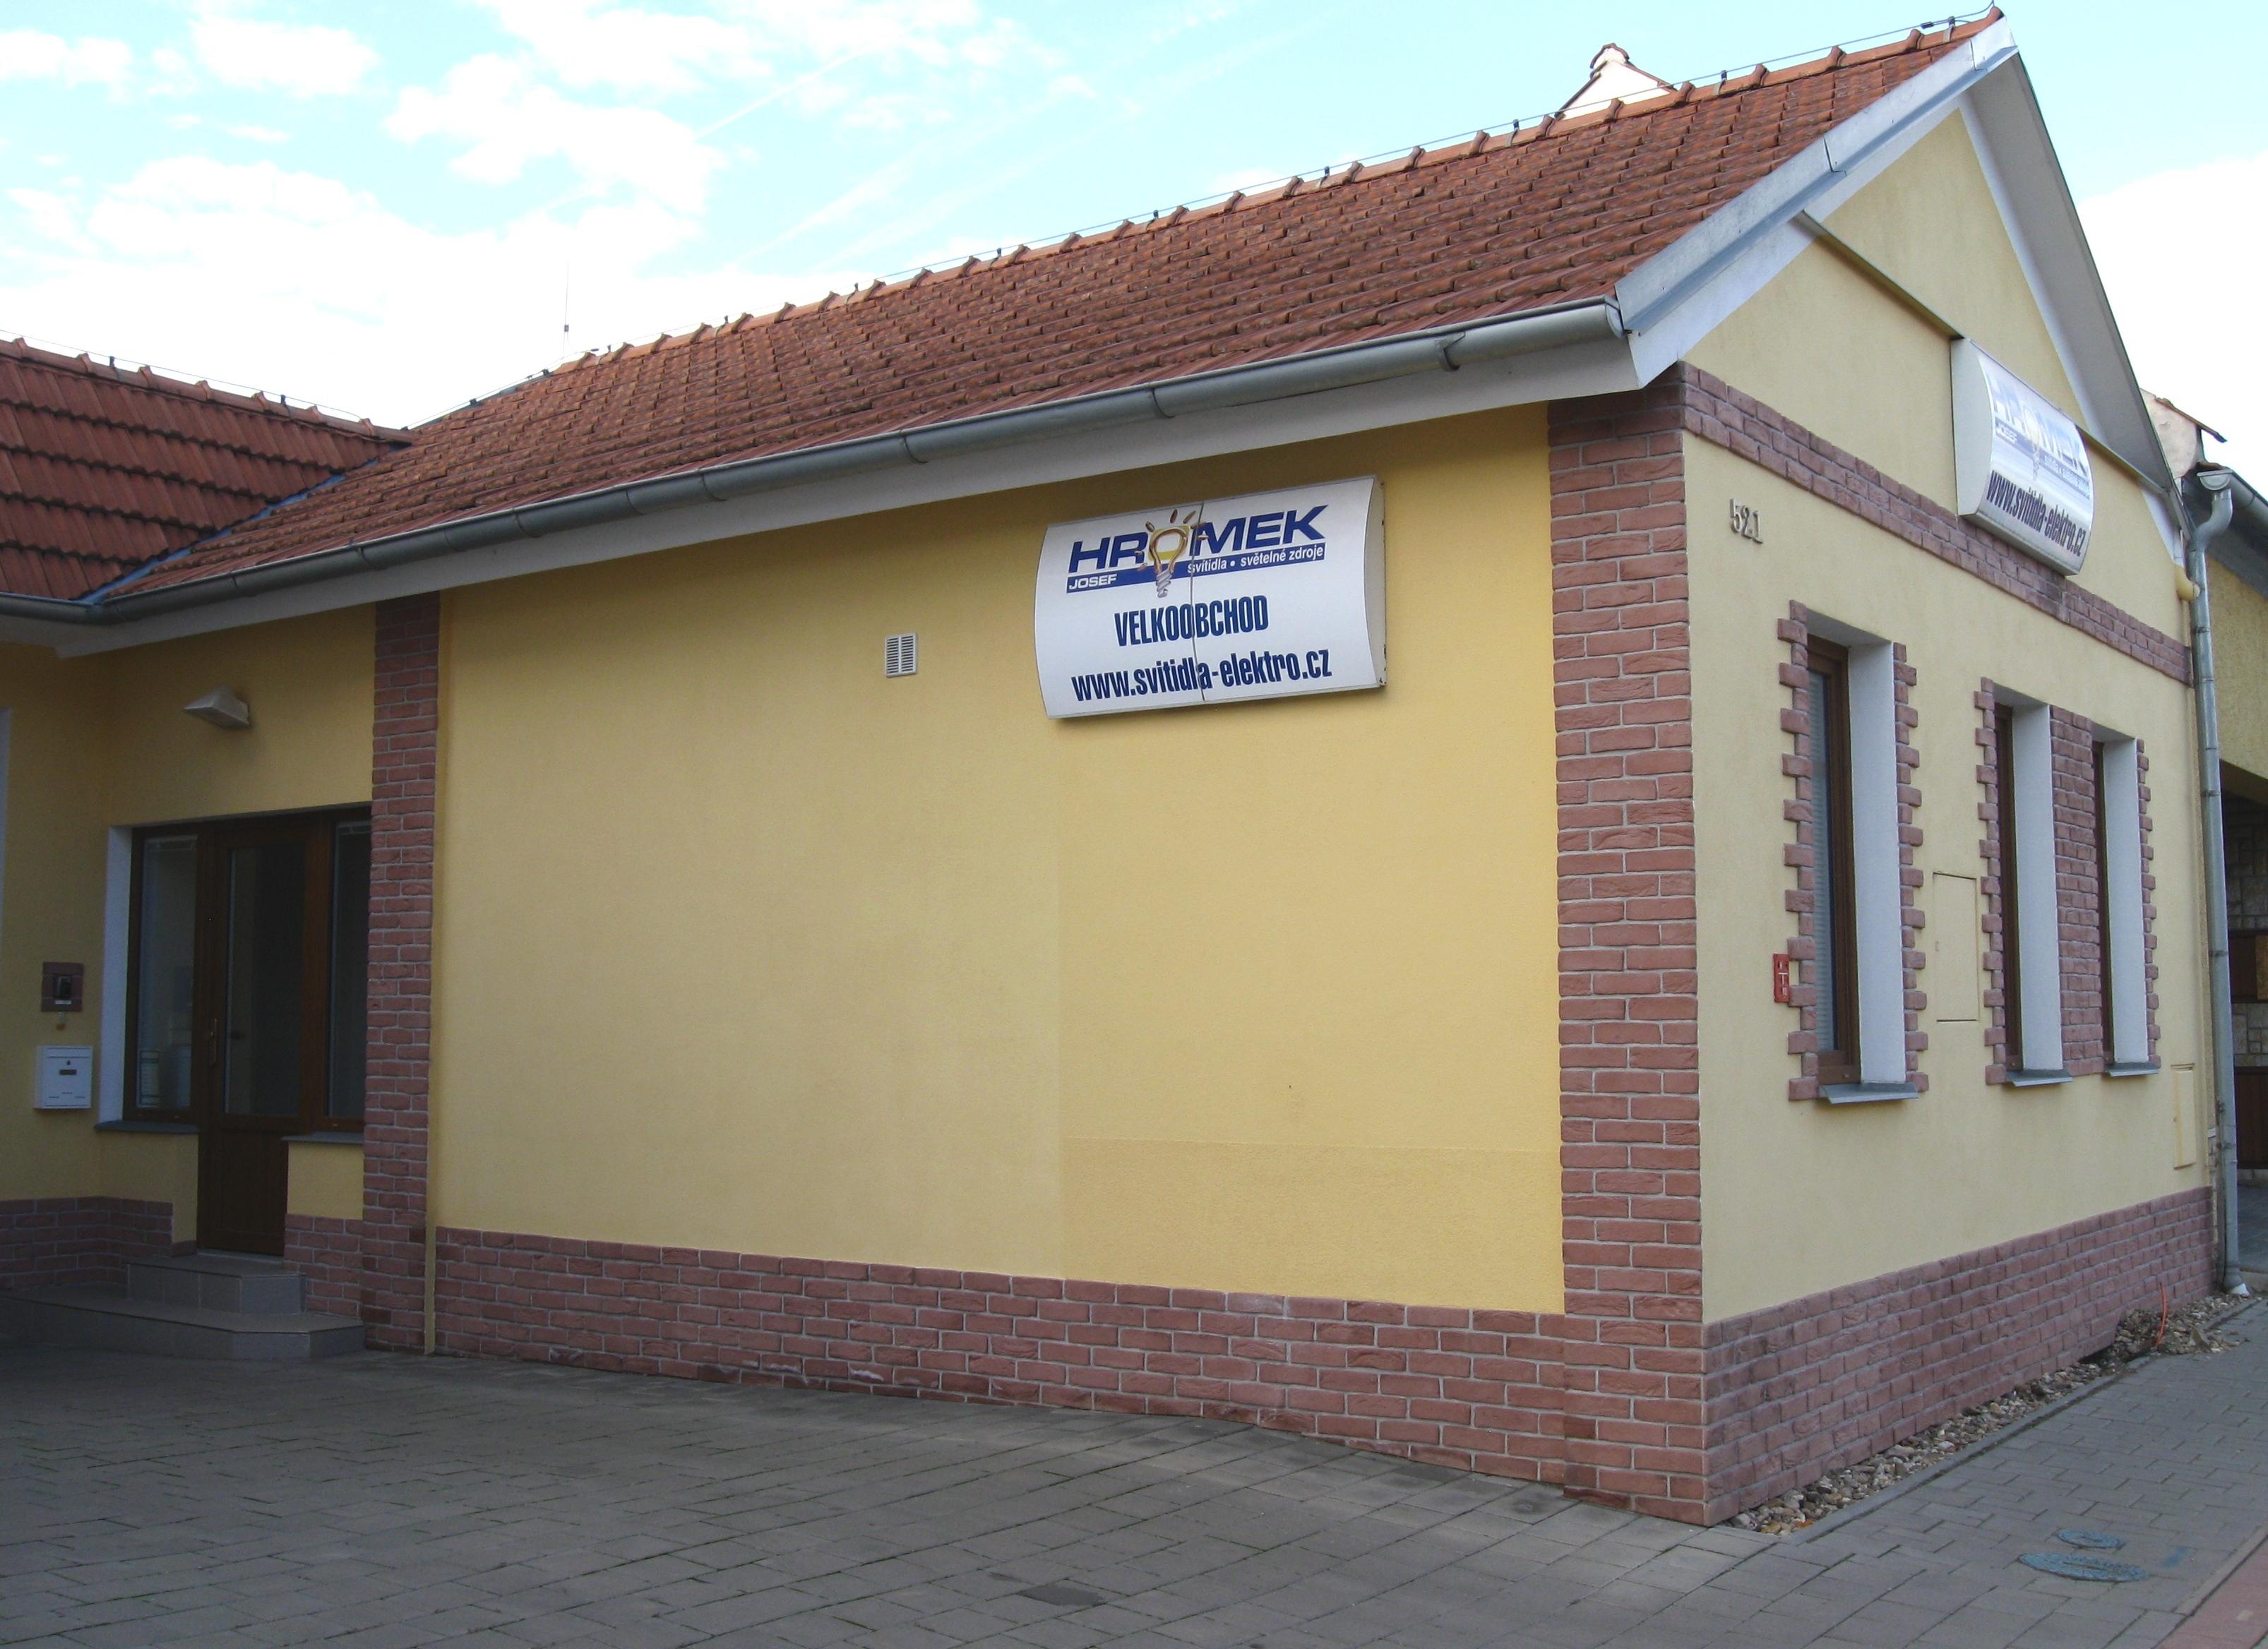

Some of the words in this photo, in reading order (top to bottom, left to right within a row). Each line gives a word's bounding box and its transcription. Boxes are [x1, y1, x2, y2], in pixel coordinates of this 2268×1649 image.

[1729, 498, 1763, 544] 521
[1986, 469, 2086, 556] www.svitidla-elektro.cz
[1068, 504, 1328, 573] HROMEK
[1188, 558, 1227, 573] svítidla
[1240, 549, 1287, 568] světelné
[1289, 544, 1324, 561] zdroje
[1069, 573, 1118, 590] JOSEF
[1114, 595, 1268, 646] VELKOOBCHOD
[1071, 649, 1332, 701] www.svitidla-elektro.cz
